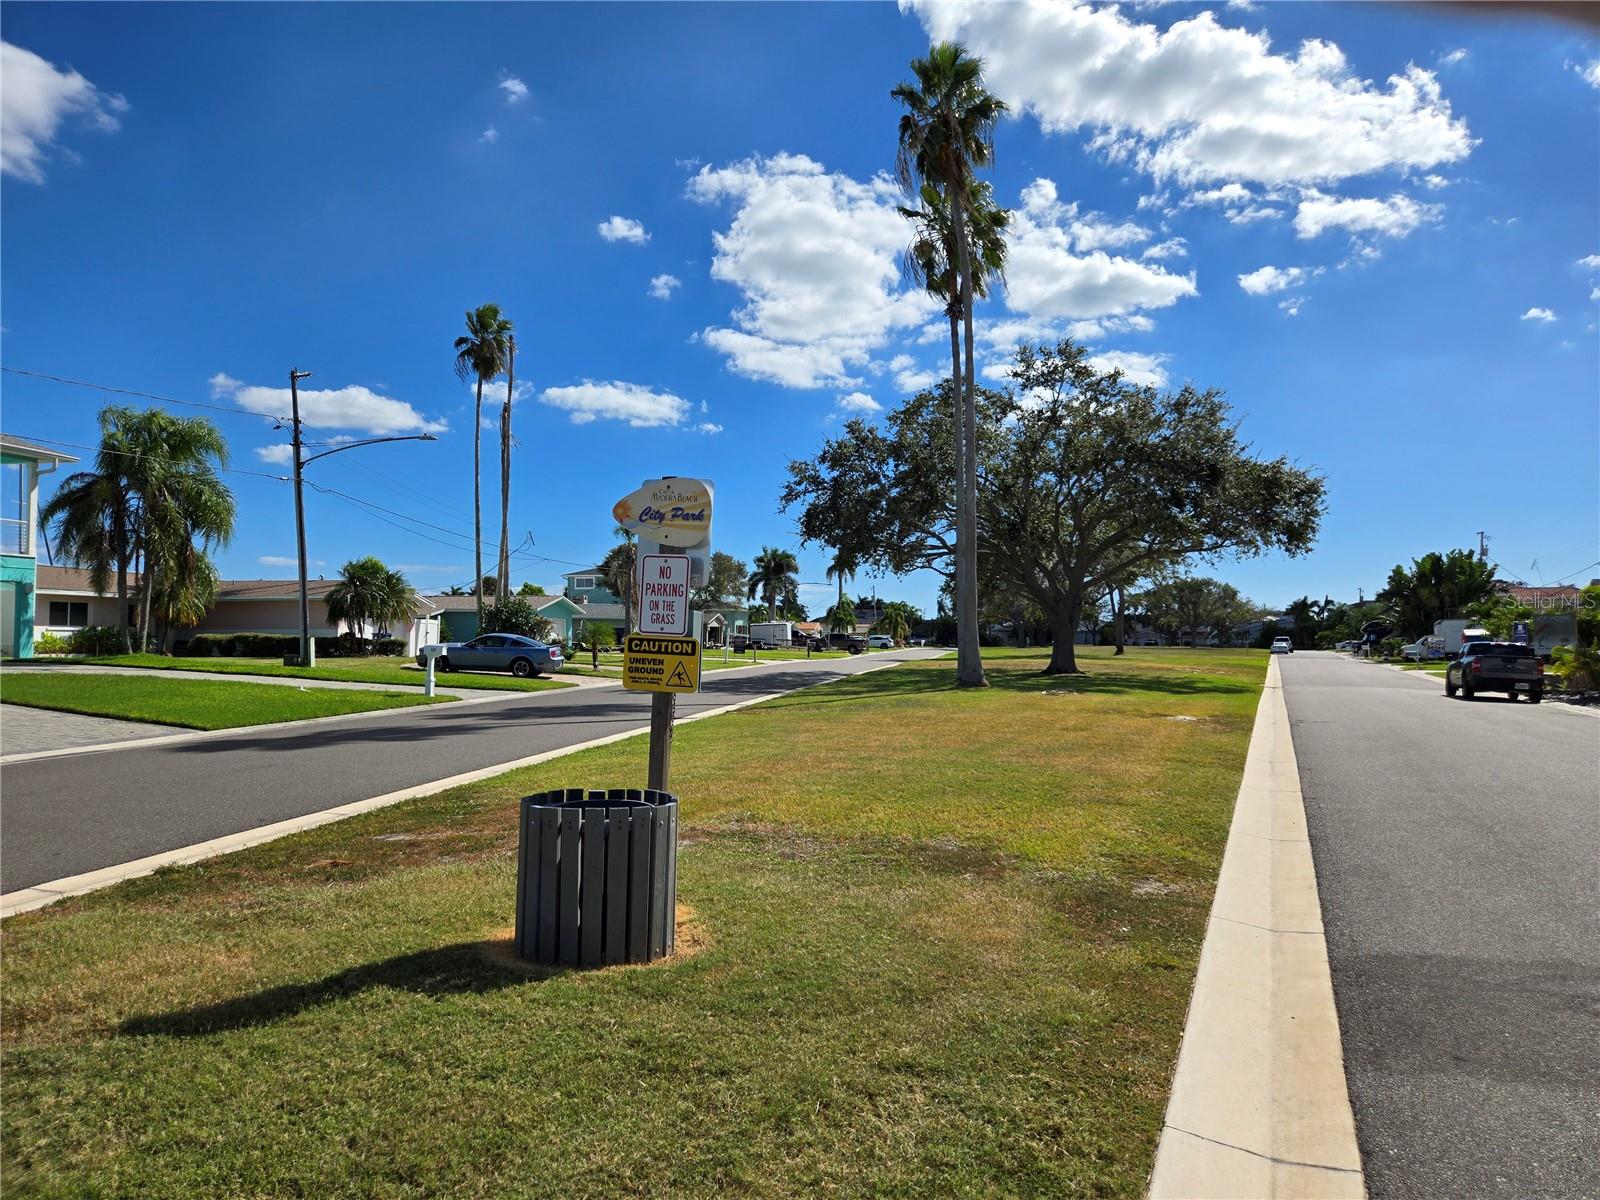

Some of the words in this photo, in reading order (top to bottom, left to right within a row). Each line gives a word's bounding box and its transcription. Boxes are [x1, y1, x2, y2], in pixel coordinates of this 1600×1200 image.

[677, 492, 698, 502] BEACH
[639, 506, 665, 523] City
[670, 507, 705, 522] Park
[659, 566, 672, 579] NO
[645, 583, 684, 597] PARKING
[649, 600, 659, 611] ON
[662, 601, 675, 612] THE
[650, 613, 675, 625] GRASS
[631, 640, 692, 654] CAUTION
[629, 657, 665, 666] UNEVEN
[628, 666, 665, 675] GROUND
